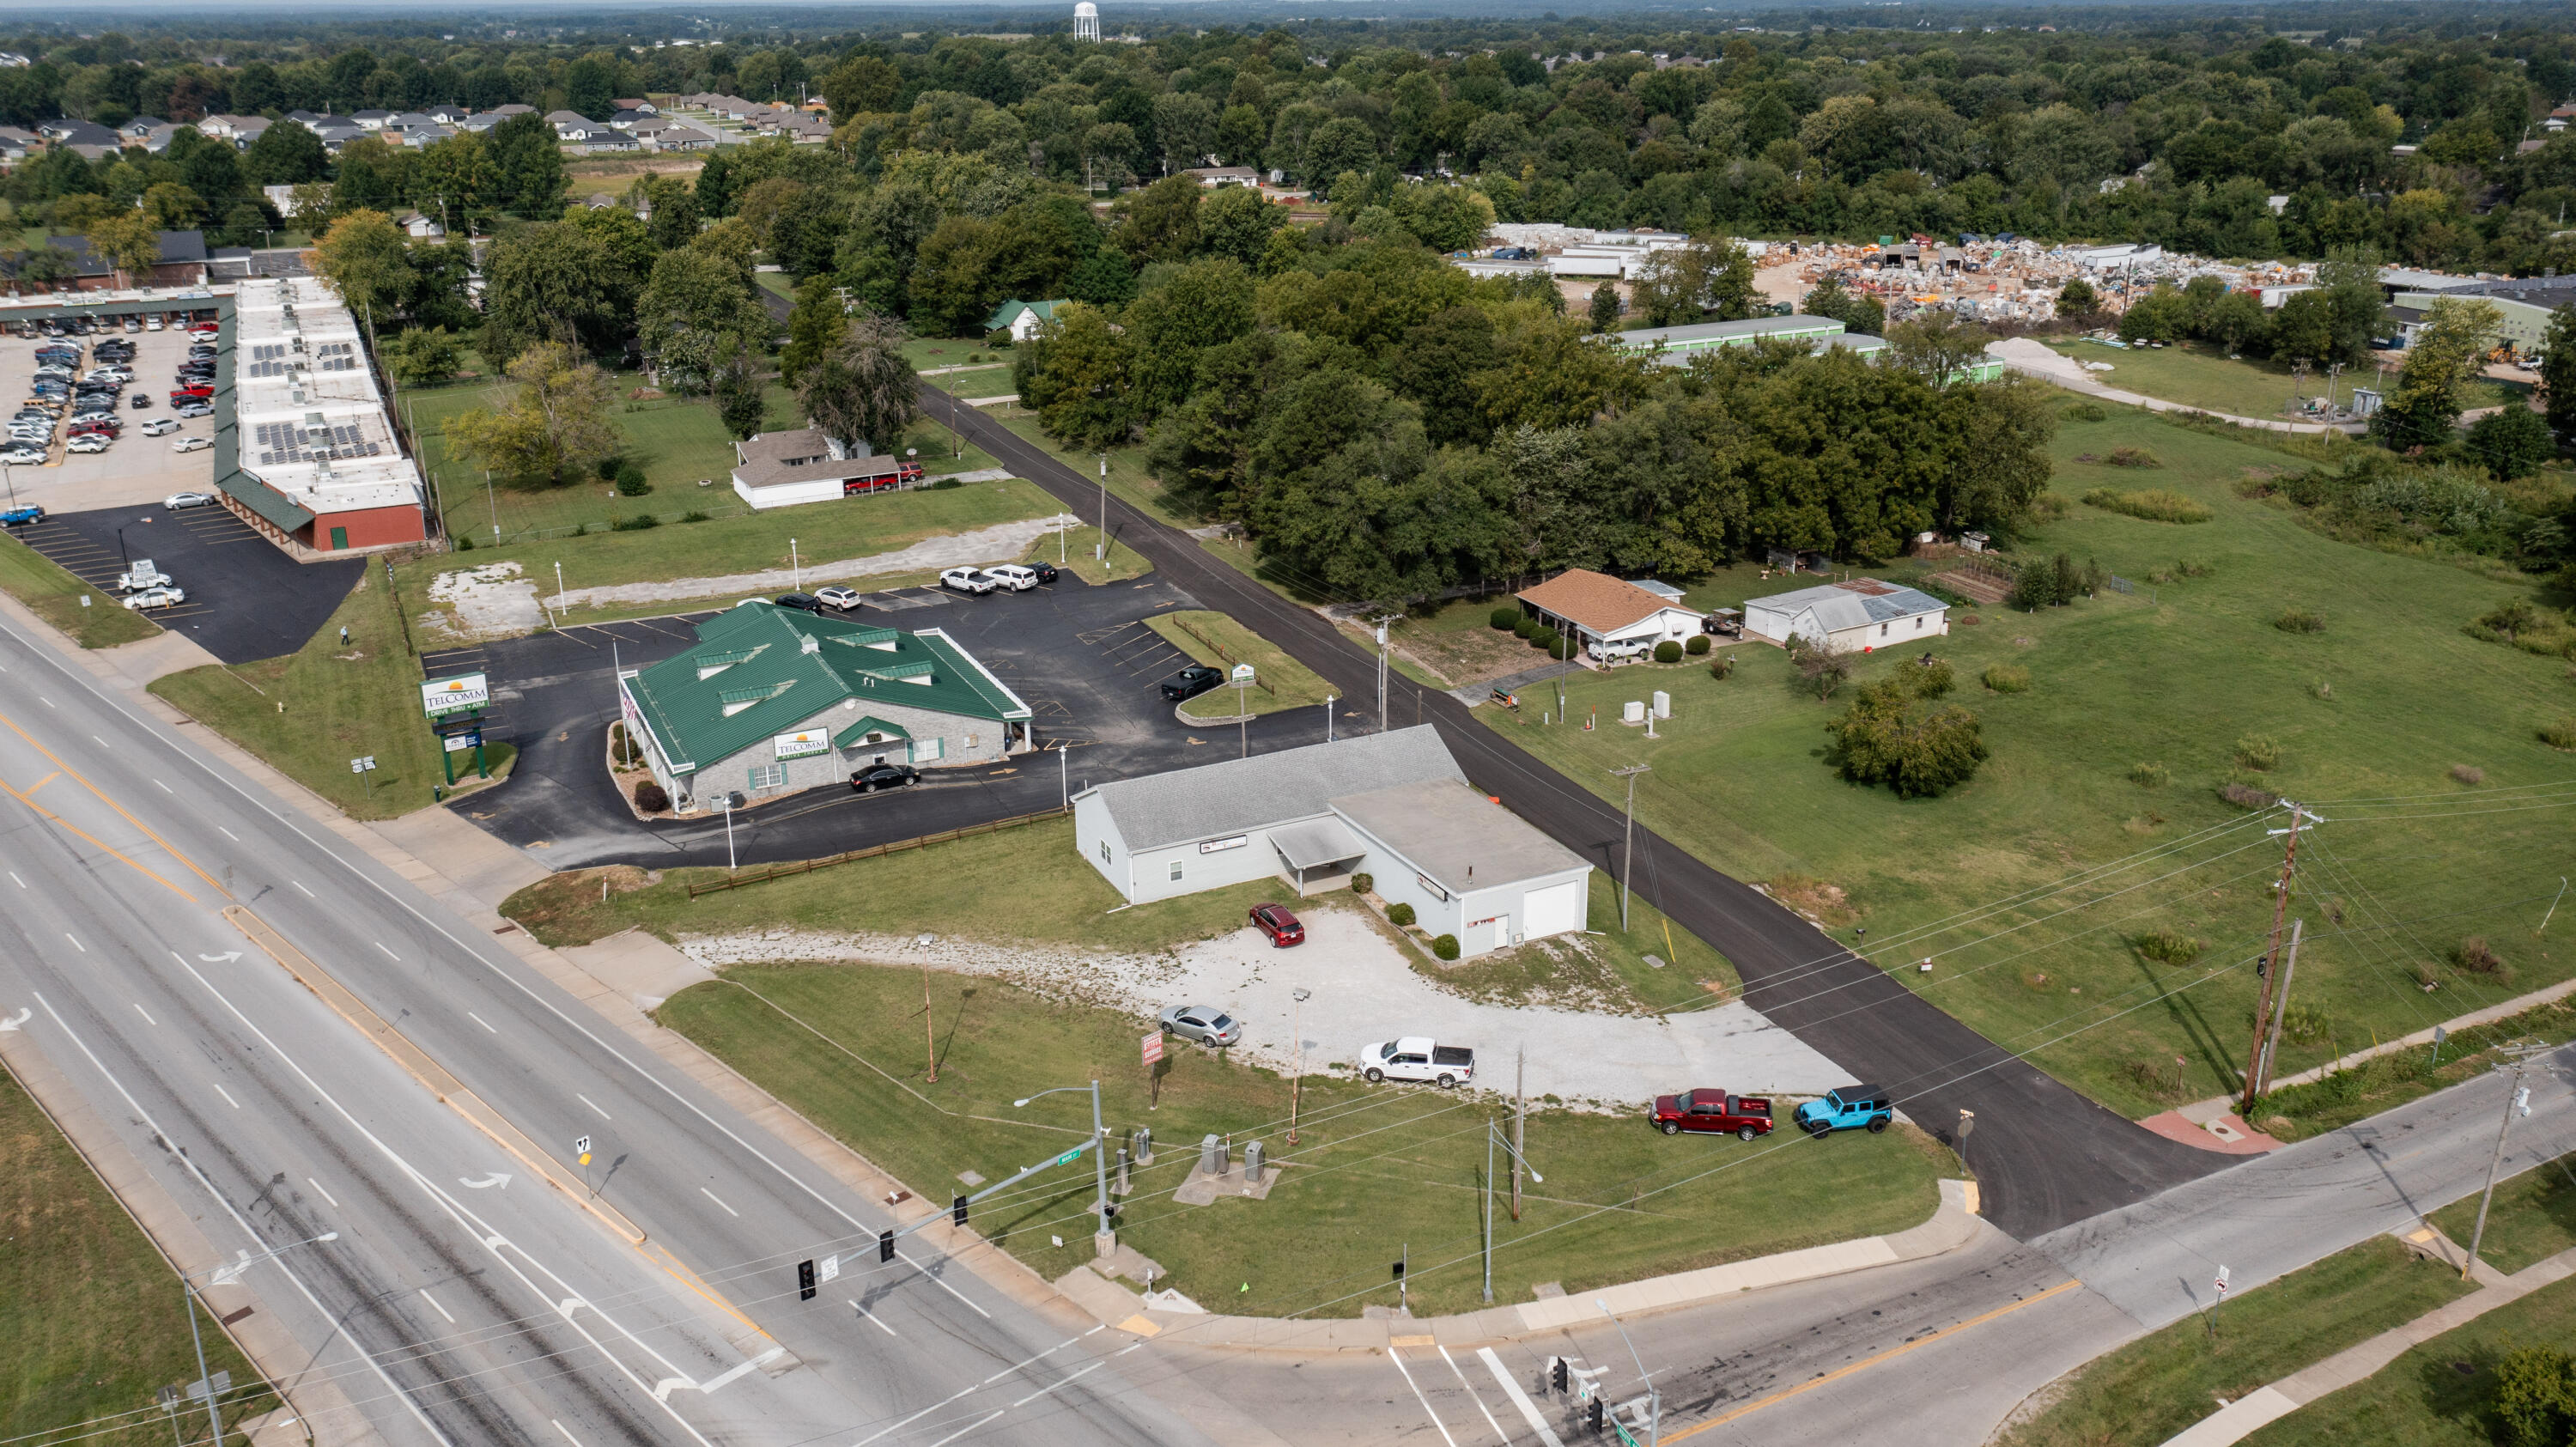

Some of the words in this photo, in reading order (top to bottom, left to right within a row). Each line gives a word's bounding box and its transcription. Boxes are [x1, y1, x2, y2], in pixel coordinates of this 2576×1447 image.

[426, 689, 487, 707] TELCOMM
[430, 708, 449, 717] DRIVE
[779, 741, 825, 754] TELCOMM
[1145, 1046, 1162, 1058] SERVICE
[1061, 1154, 1072, 1163] MAIN
